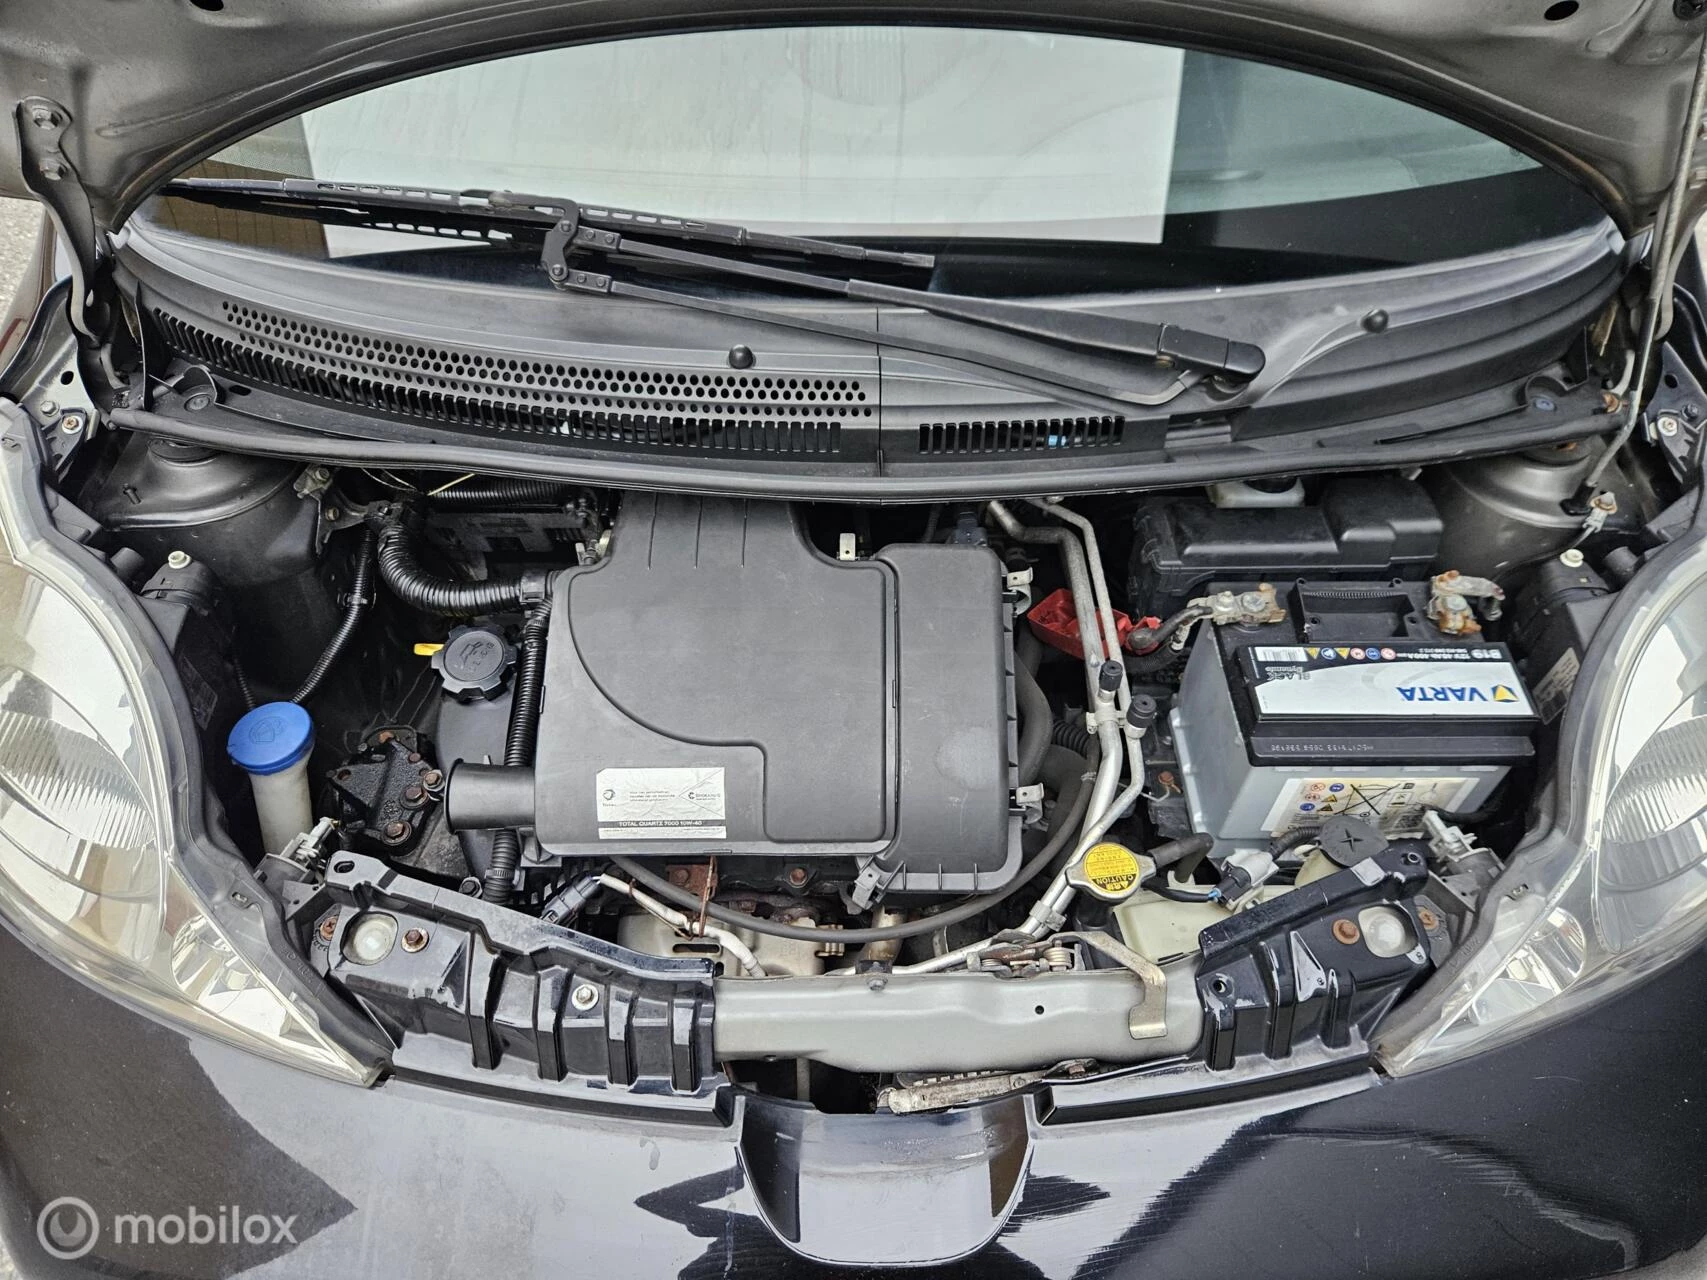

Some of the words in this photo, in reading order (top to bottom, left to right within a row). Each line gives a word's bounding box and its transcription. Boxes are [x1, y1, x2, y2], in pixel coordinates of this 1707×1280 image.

[1471, 649, 1502, 660] B19
[1267, 672, 1311, 681] BLACK
[1396, 687, 1488, 702] VARTA
[1096, 874, 1134, 884] CAUTION
